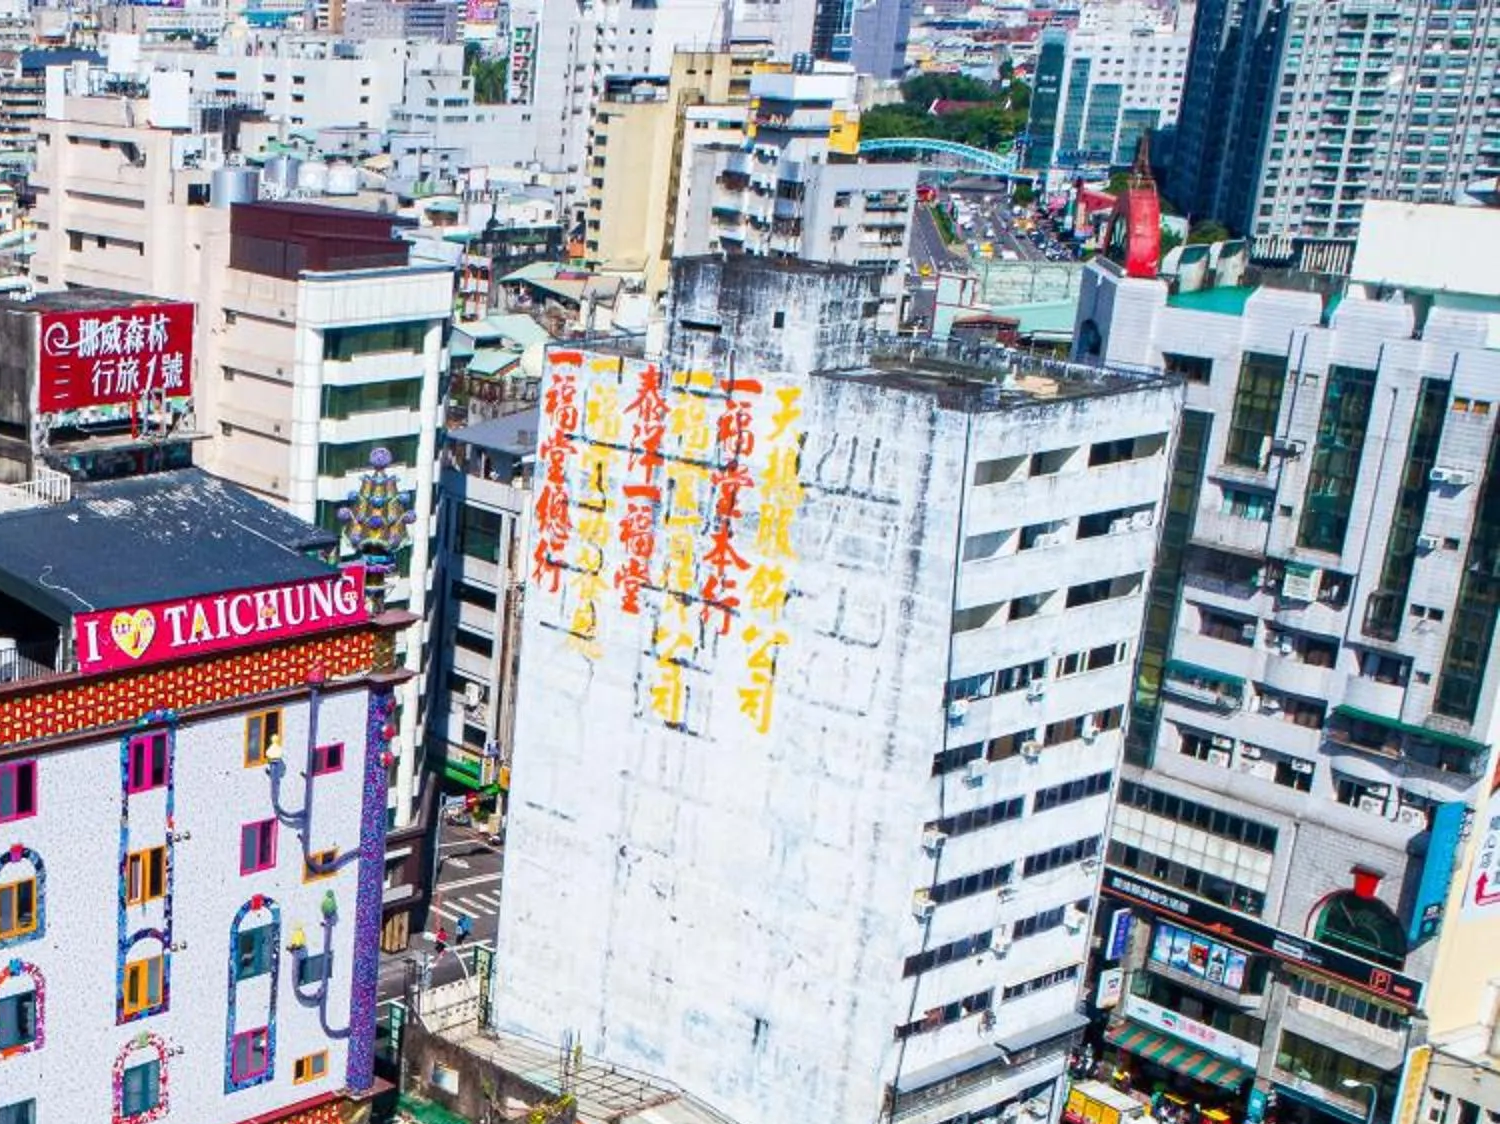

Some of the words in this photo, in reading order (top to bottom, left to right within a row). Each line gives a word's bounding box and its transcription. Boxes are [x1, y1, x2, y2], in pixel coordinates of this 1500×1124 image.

[77, 313, 170, 359] 挪威森林
[85, 620, 102, 662] I
[163, 574, 358, 647] TAICHUNG
